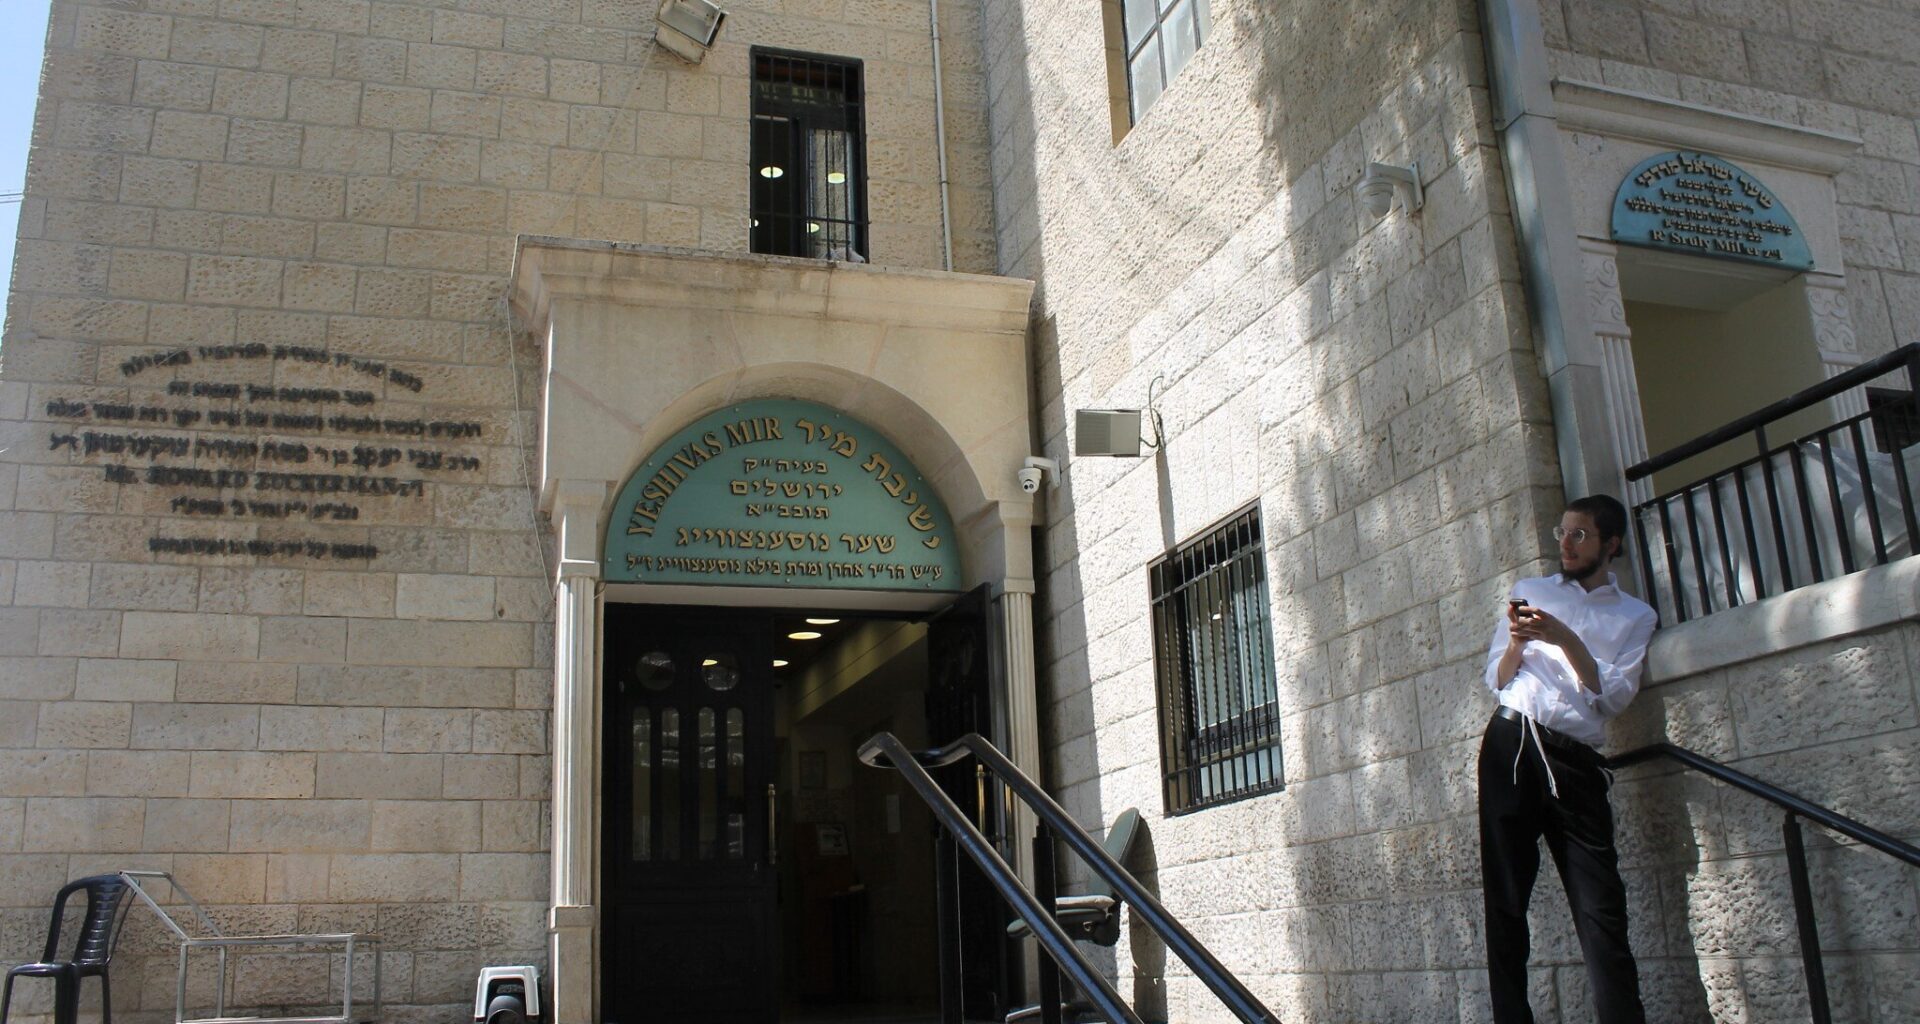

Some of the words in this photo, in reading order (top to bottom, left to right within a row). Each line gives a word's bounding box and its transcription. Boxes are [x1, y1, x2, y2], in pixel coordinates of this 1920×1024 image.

[1634, 160, 1681, 188] מרדכי
[1677, 152, 1732, 180] ישראל
[1736, 174, 1773, 209] שער
[1669, 231, 1710, 251] Sruly
[796, 419, 859, 459] מיר
[147, 465, 248, 488] HOWARD
[627, 431, 723, 537] YESHIVAS
[724, 416, 784, 448] MIR
[744, 457, 829, 475] בעיה"ק
[731, 477, 843, 500] ירושלים
[746, 503, 831, 520] תובב"א
[860, 452, 941, 549] ישיבת
[676, 527, 831, 552] נוסענצווייג
[840, 533, 897, 554] שער
[746, 556, 782, 576] בילא
[786, 559, 824, 577] ומרת
[827, 560, 865, 580] אהרן
